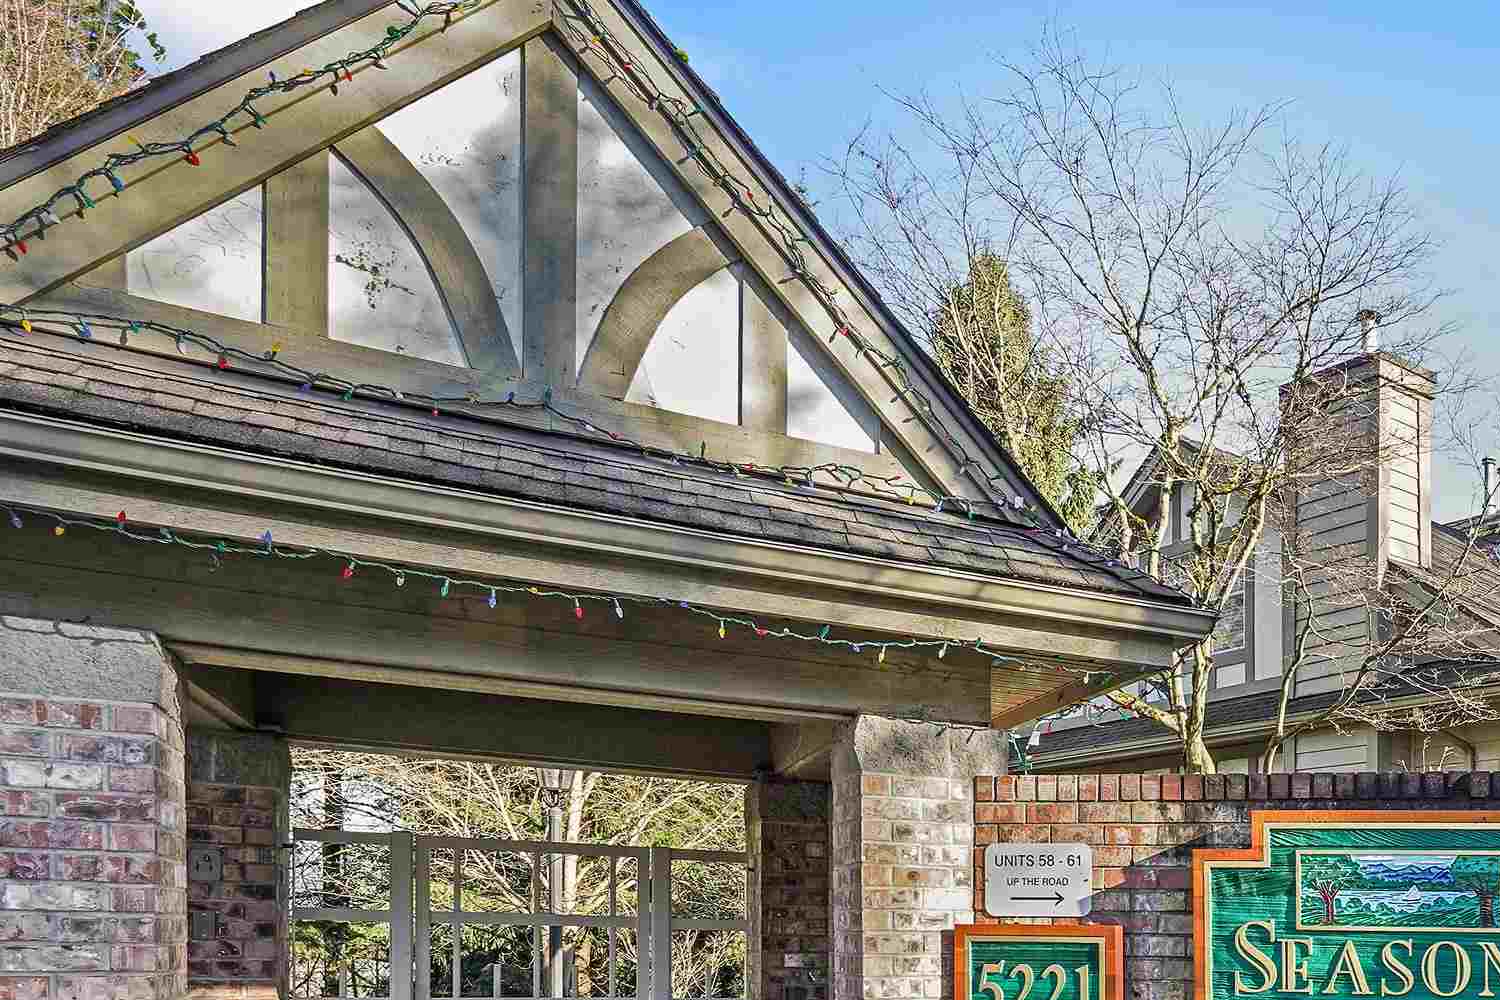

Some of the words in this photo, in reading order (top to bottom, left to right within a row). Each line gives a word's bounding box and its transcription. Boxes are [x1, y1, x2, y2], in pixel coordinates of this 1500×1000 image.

[994, 854, 1035, 867] UNITS
[1039, 854, 1055, 867] 58
[1067, 854, 1081, 867] 61
[1006, 877, 1019, 887] UP
[1022, 877, 1040, 887] THE
[1042, 877, 1069, 887] ROAD
